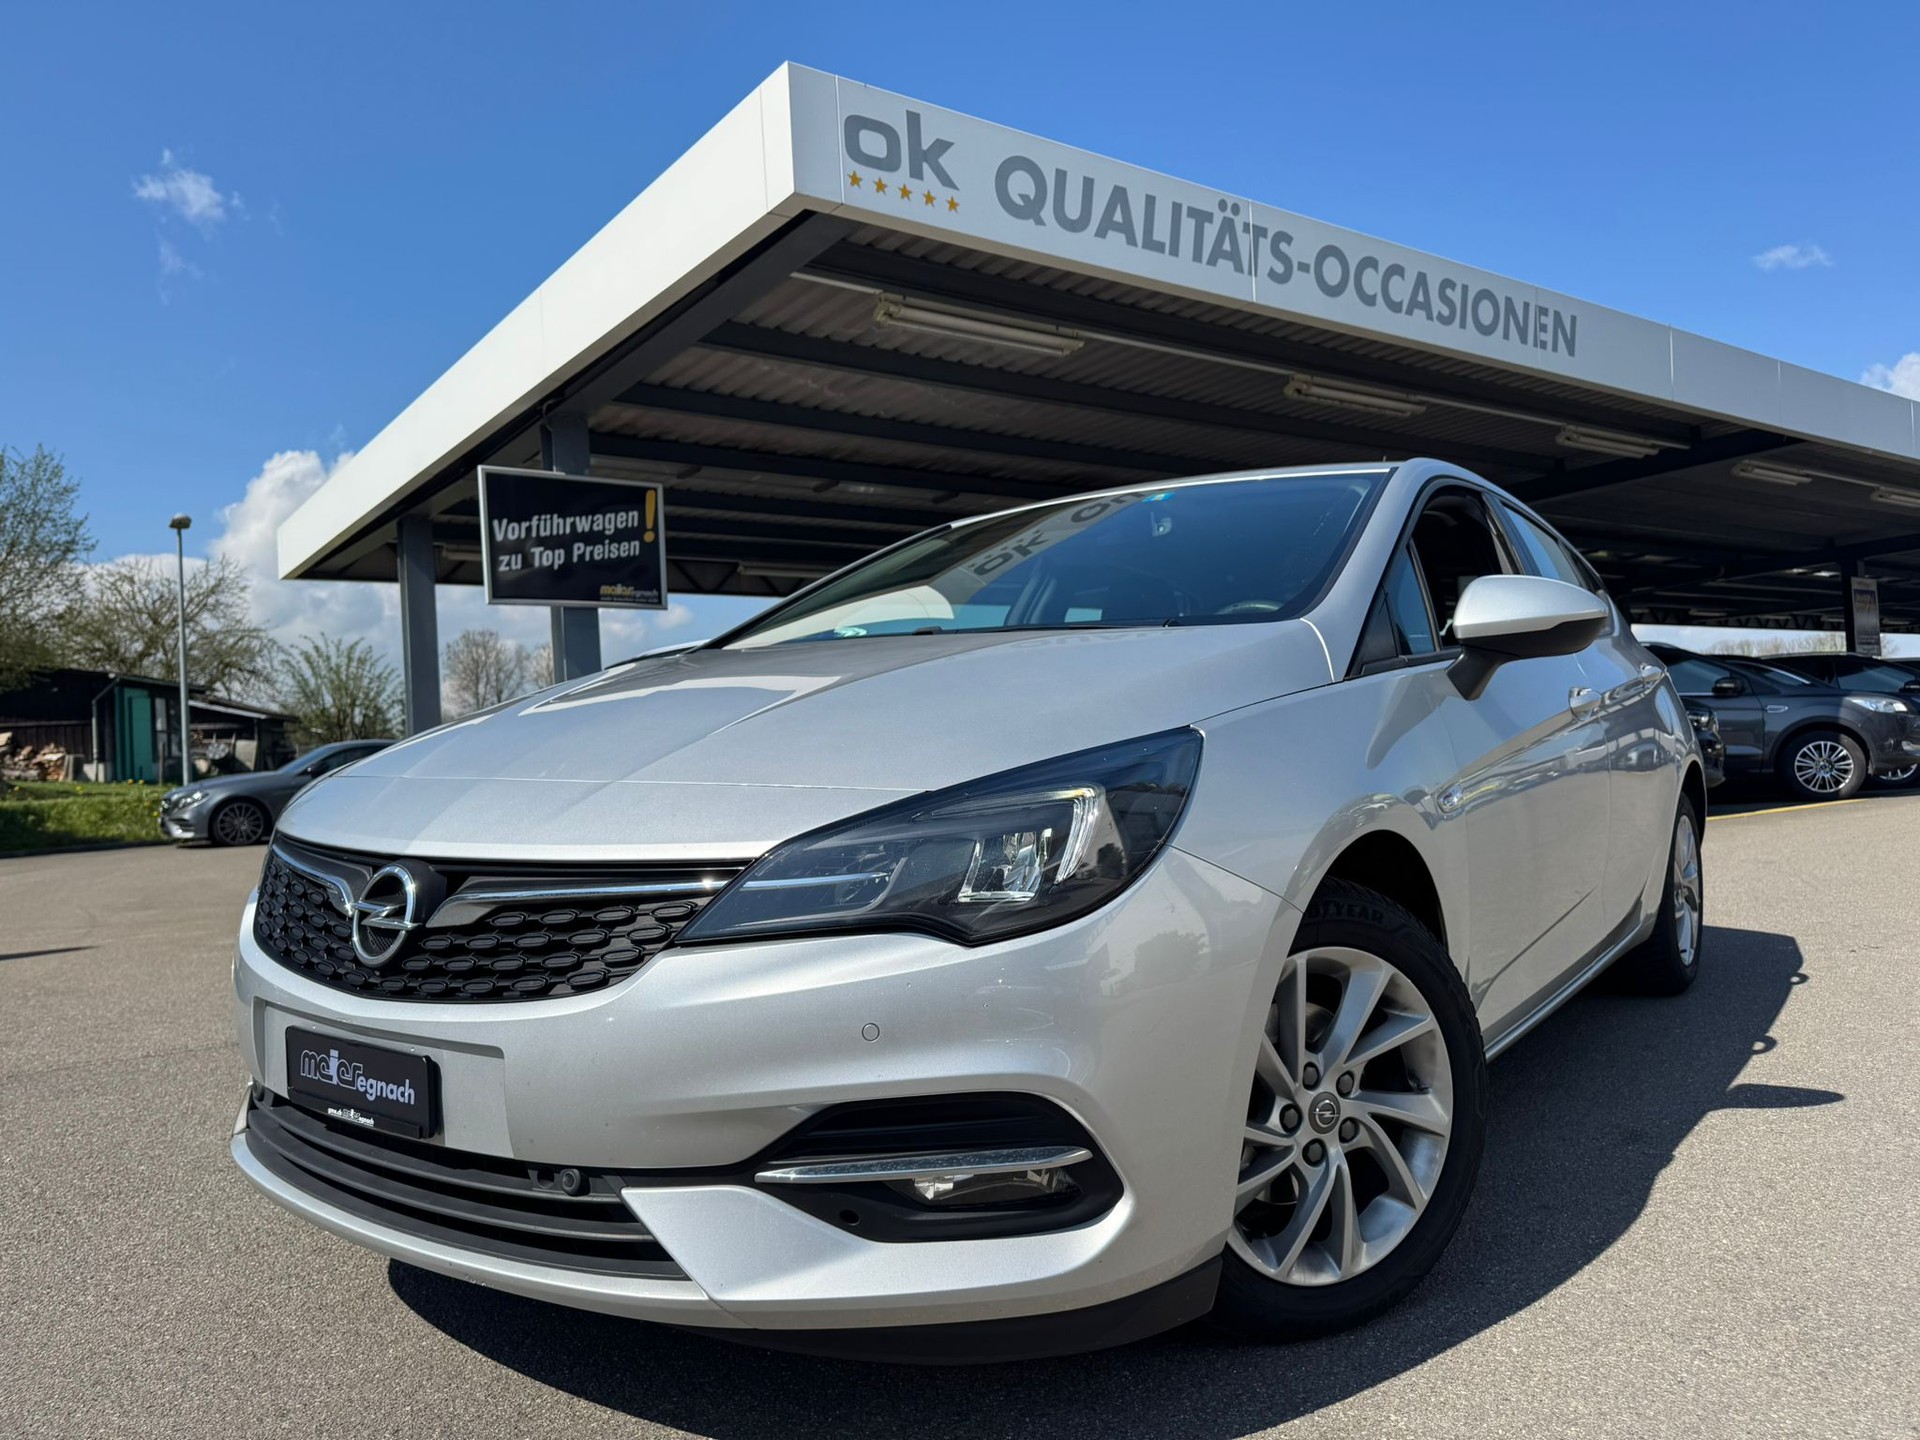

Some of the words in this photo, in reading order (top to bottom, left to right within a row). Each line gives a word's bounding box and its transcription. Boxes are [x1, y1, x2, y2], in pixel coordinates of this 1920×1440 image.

[844, 109, 960, 191] ok
[995, 155, 1577, 358] QUALITÄTS-OCCASIONEN
[492, 510, 639, 542] Vorführwagen
[498, 553, 522, 572] zu
[530, 546, 565, 571] Top
[573, 540, 640, 563] Preisen
